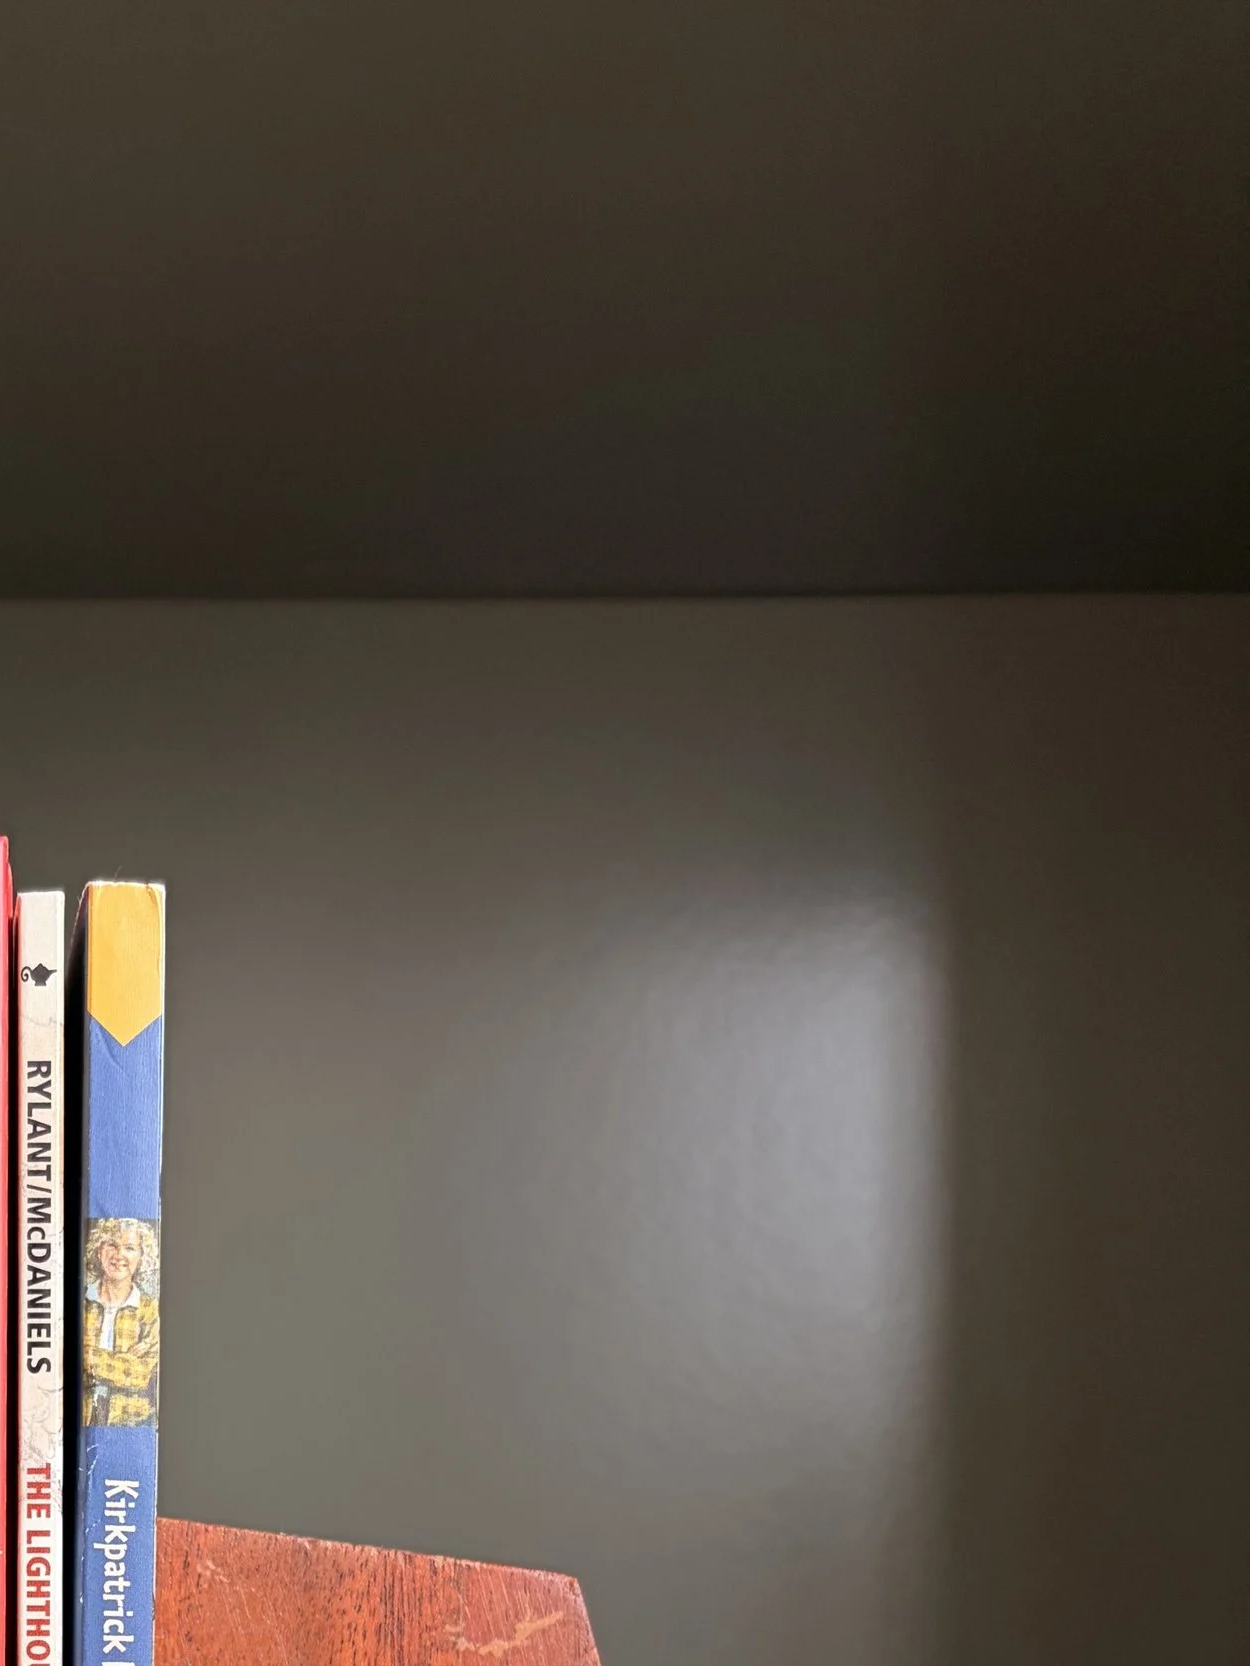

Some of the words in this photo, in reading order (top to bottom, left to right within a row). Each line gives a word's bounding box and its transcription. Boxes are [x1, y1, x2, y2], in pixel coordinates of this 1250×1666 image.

[25, 1060, 53, 1375] RYLANT/McDANIELS
[25, 1463, 51, 1520] THE
[93, 1480, 139, 1652] Kirkpatrick
